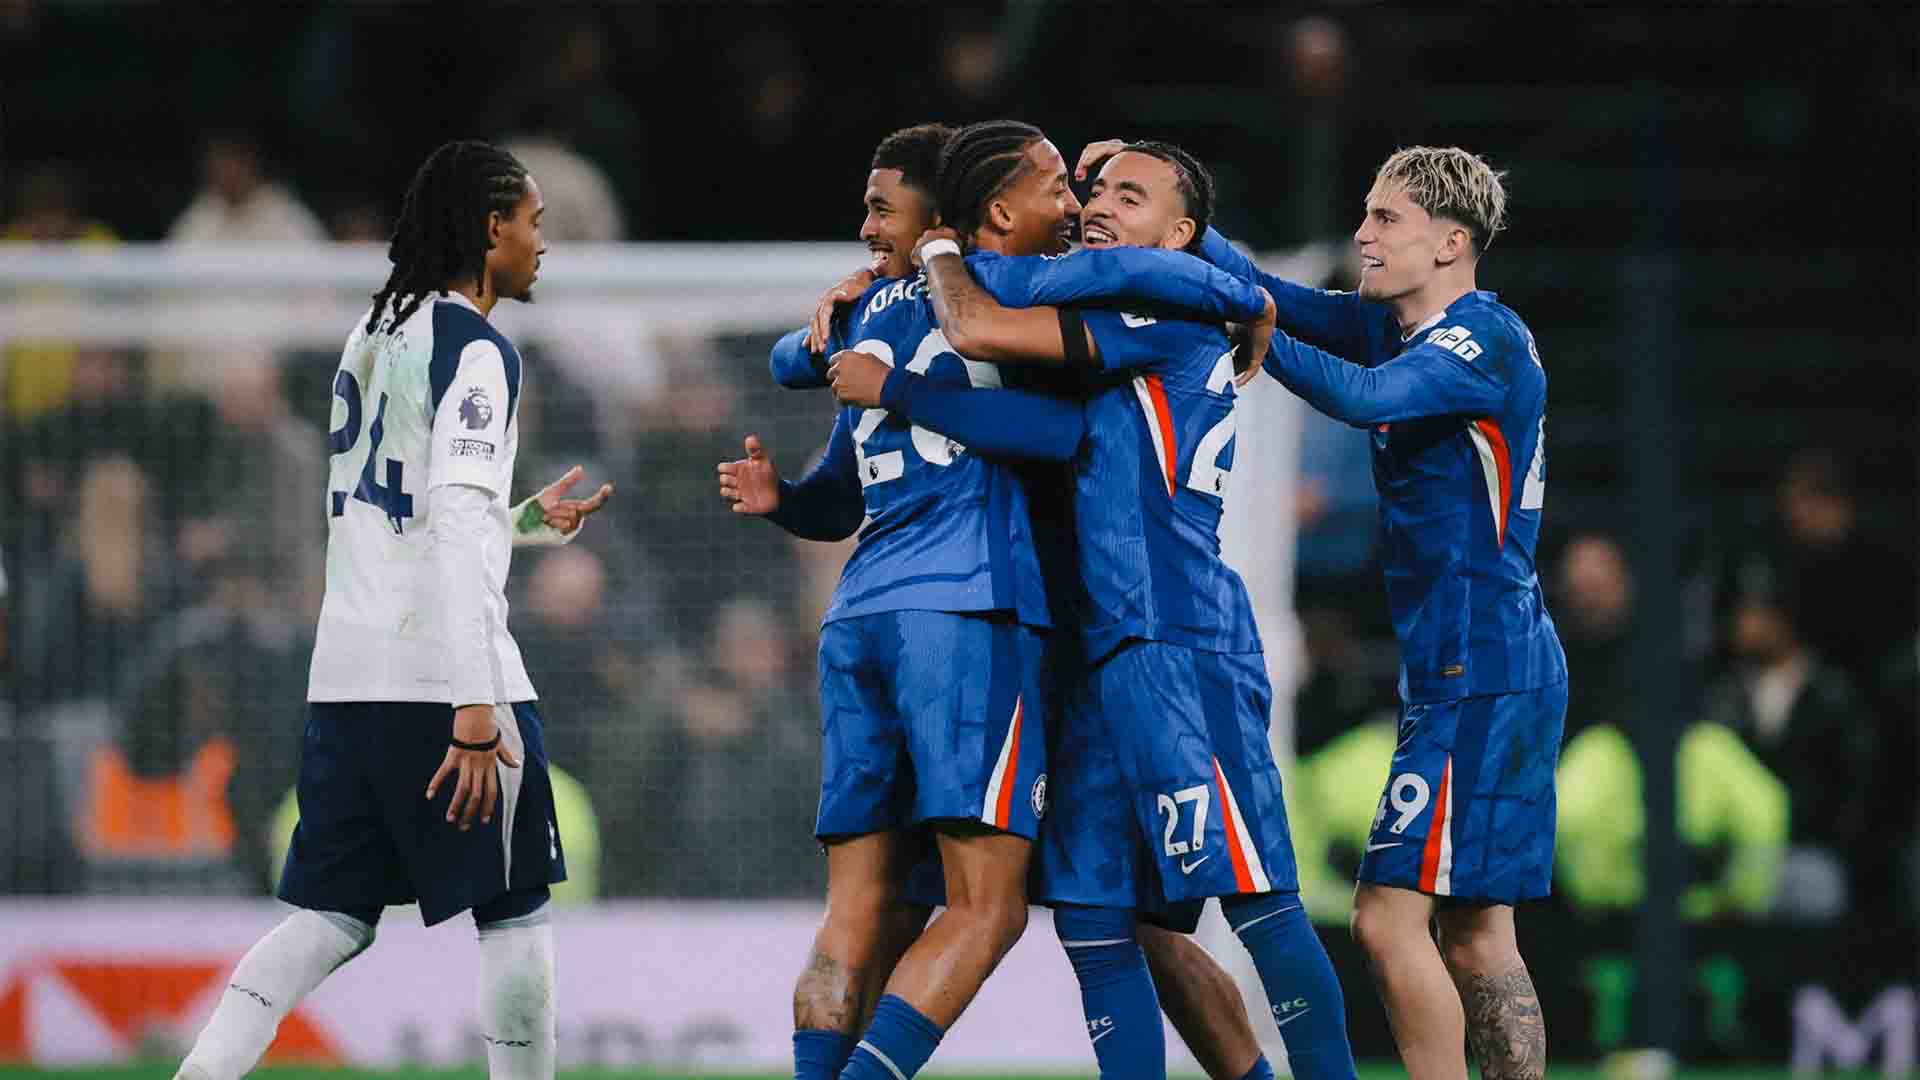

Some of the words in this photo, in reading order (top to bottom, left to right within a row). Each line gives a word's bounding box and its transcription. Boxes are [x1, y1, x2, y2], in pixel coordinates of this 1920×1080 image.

[329, 369, 413, 532] 24
[1158, 784, 1209, 856] 27
[1087, 1016, 1112, 1030] FC
